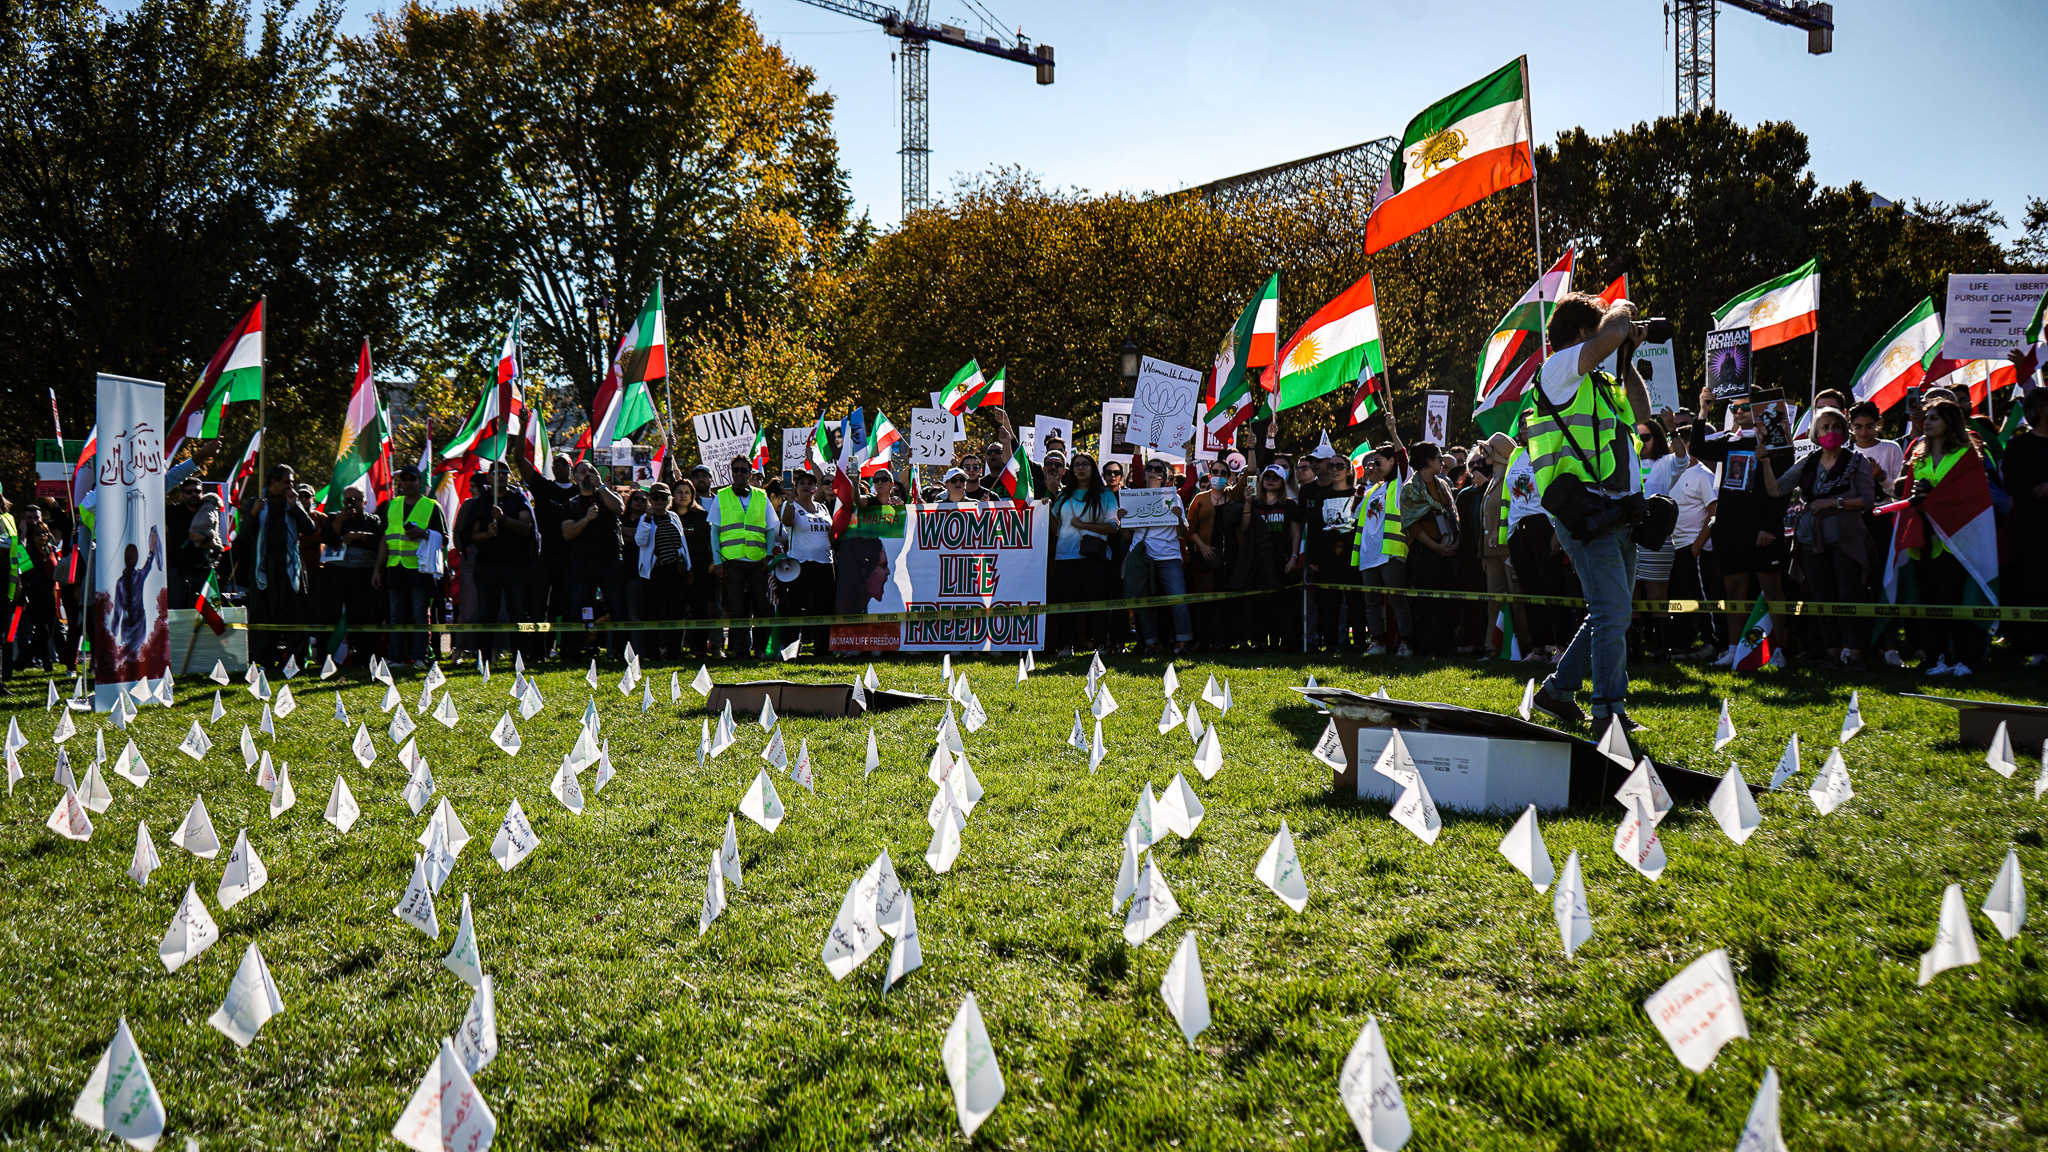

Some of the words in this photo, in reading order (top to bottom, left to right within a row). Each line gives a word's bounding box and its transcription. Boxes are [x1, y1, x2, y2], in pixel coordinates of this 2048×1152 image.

[1969, 282, 1989, 291] LIFE
[2015, 282, 2048, 291] LIBERTY
[1955, 294, 1989, 302] PURSUIT
[1991, 294, 2005, 303] OF
[2006, 293, 2042, 303] HAPPIN
[1707, 330, 1749, 345] WOMAN
[1959, 327, 1992, 335] WOMEN
[2008, 327, 2027, 336] LIFE
[1720, 338, 1749, 349] FREEDOM
[1970, 338, 2019, 347] FREEDOM
[917, 412, 947, 425] قادسیه
[697, 410, 756, 442] JINA
[915, 430, 945, 442] ادامه
[862, 513, 900, 525] MAHSA
[916, 506, 1034, 550] WOMAN
[938, 553, 1000, 597] LIFE
[904, 601, 1041, 645] FREEDOM
[830, 636, 854, 646] WOMAN
[855, 636, 869, 646] LIFE
[869, 636, 900, 646] FREEDOM
